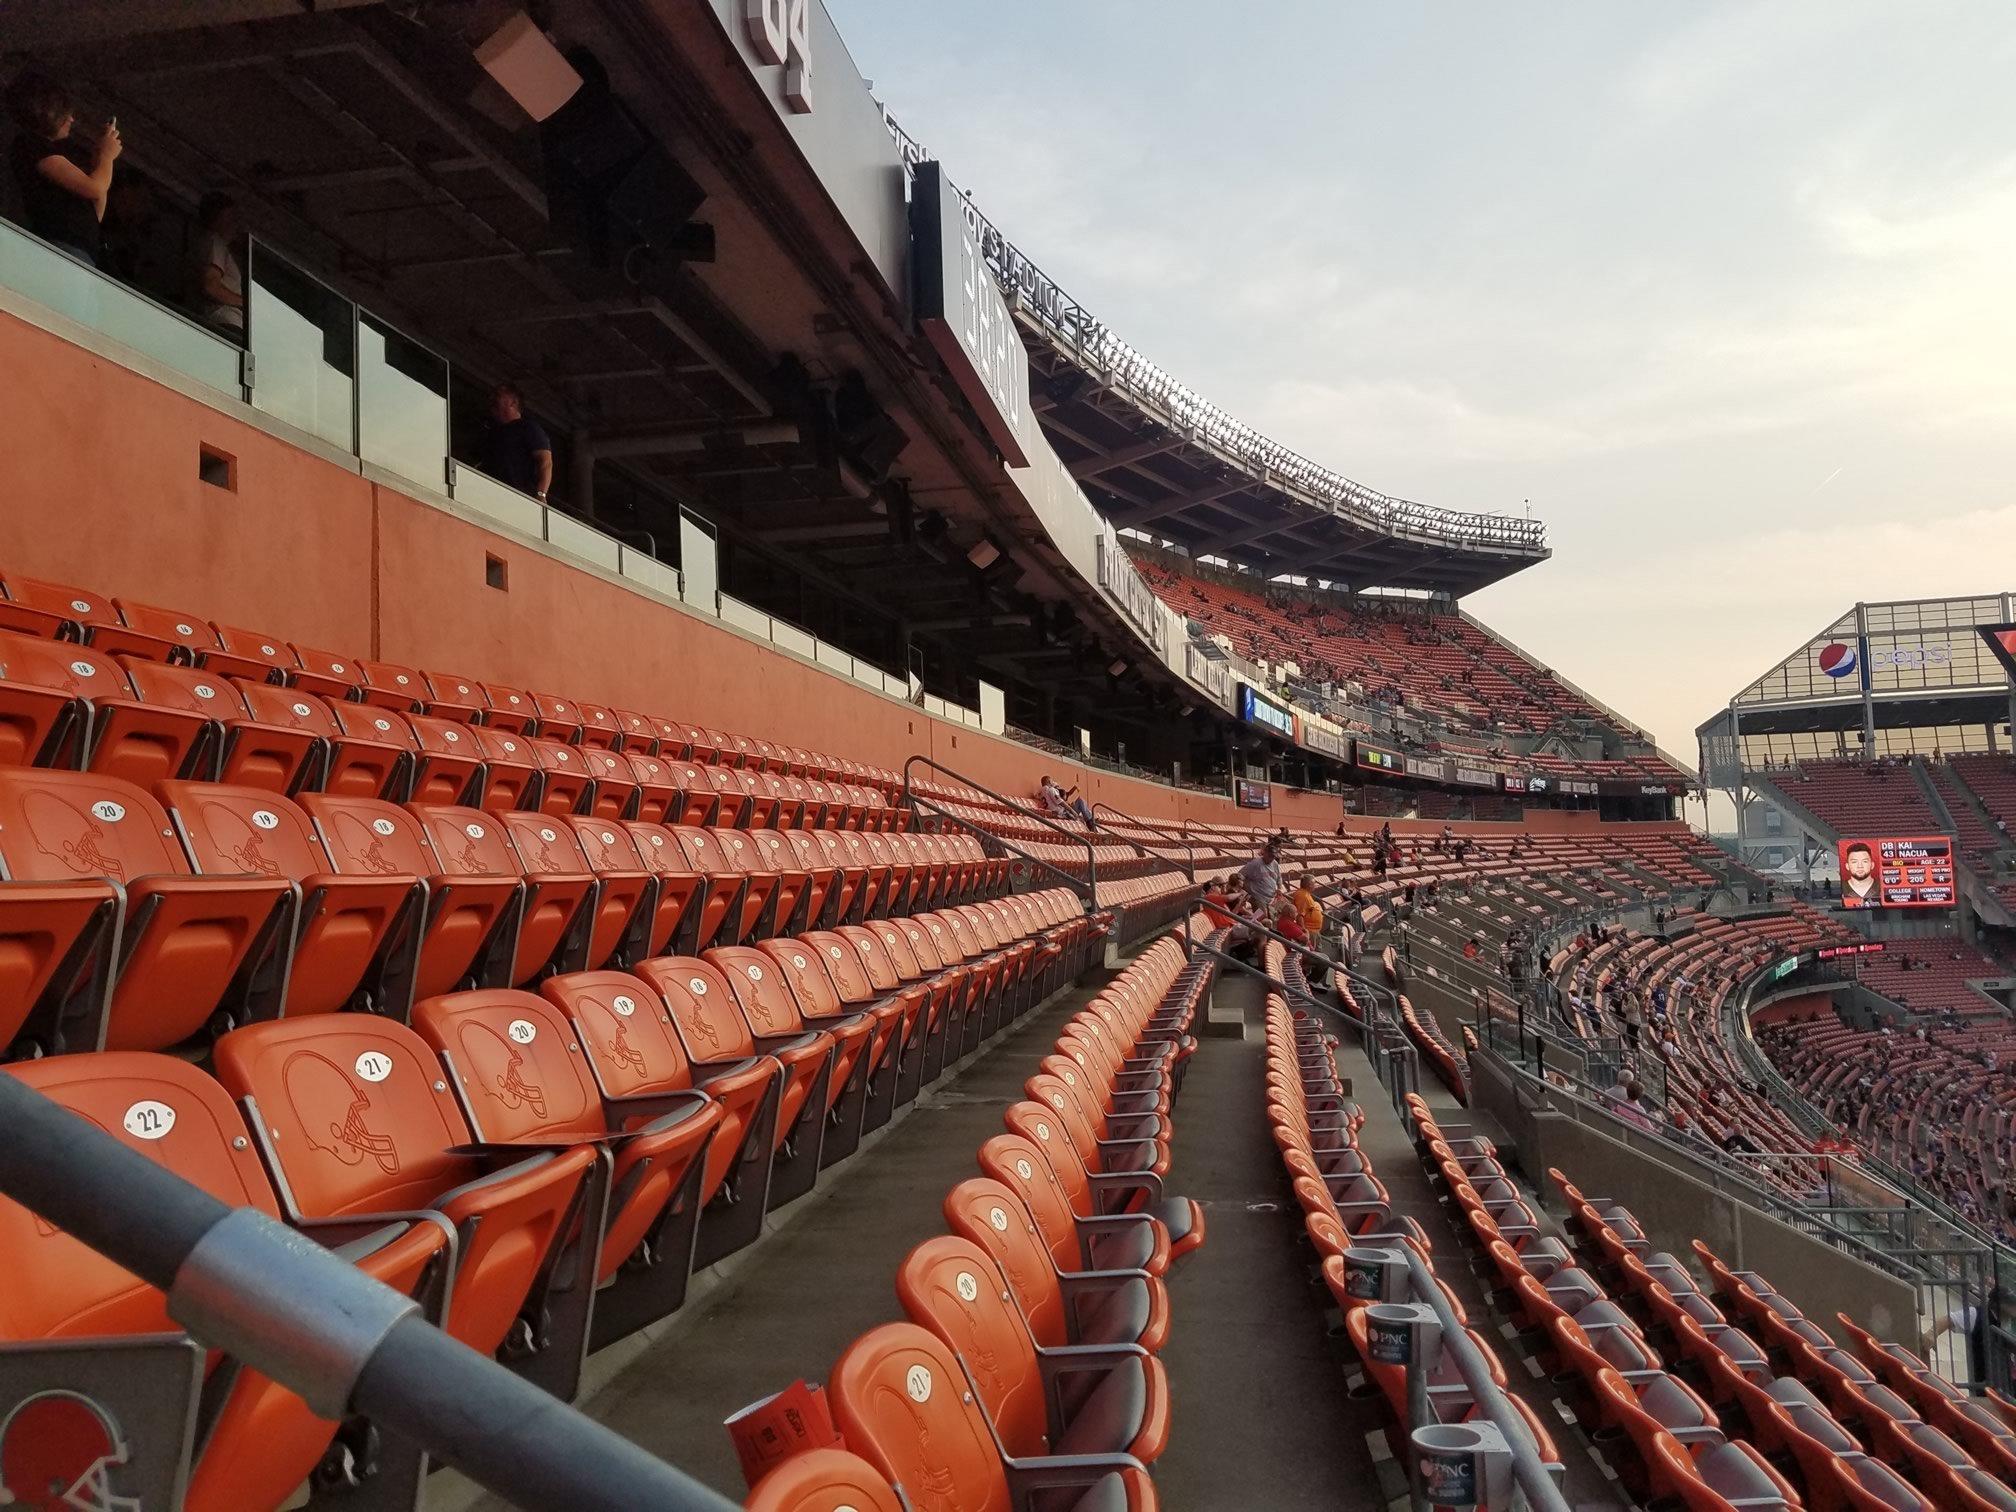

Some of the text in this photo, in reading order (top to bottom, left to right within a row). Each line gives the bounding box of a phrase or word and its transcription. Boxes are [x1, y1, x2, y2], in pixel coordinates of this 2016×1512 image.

[987, 227, 1065, 327] STADIUM
[1871, 641, 1952, 671] pepsi
[77, 664, 89, 674] 18
[1641, 785, 1667, 795] KeyBank
[100, 806, 116, 818] 20
[260, 814, 272, 826] 19
[378, 822, 390, 832] 18
[470, 827, 479, 836] 17
[1882, 842, 1894, 850] DB
[693, 982, 704, 992] 18
[617, 999, 629, 1011] 19
[515, 1026, 529, 1039] 20
[364, 1057, 382, 1076] 21
[136, 1109, 162, 1132] 22
[961, 1278, 973, 1296] 20
[1381, 1332, 1408, 1345] PNC
[911, 1373, 926, 1396] 21
